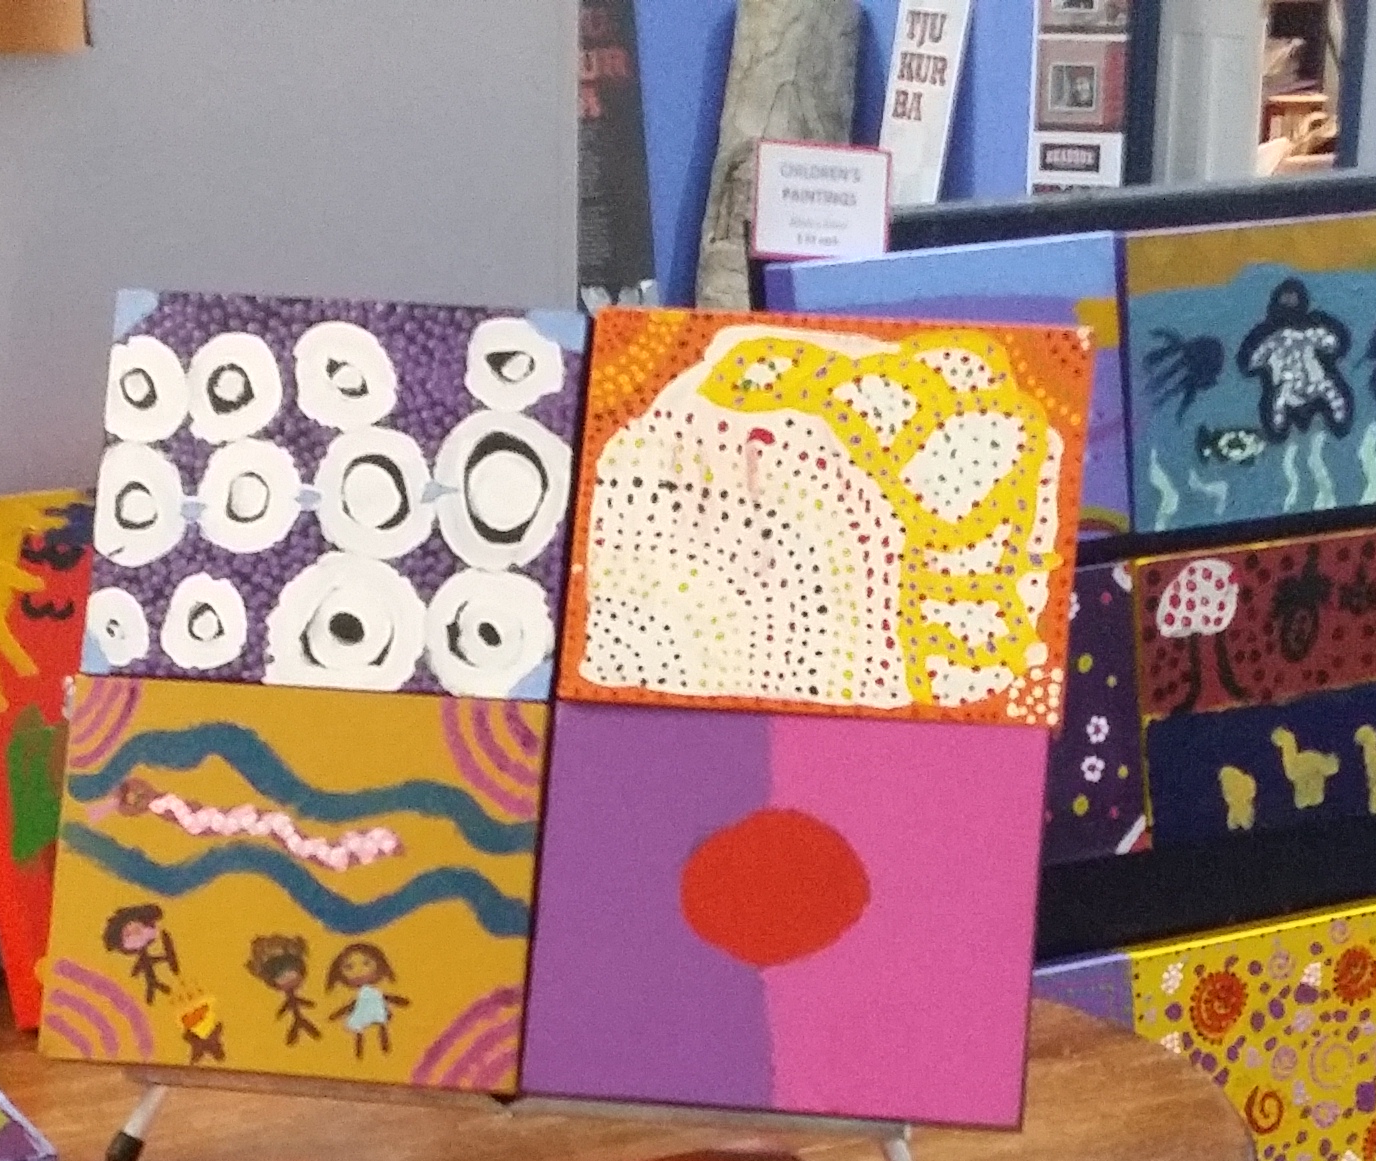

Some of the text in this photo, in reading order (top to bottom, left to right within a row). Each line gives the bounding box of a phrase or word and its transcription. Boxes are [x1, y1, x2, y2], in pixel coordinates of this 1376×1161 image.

[905, 9, 947, 48] TJU
[897, 52, 948, 87] KUR
[891, 90, 923, 121] BA
[780, 162, 861, 183] CHILDREN'S
[782, 187, 857, 206] PAINTINGS
